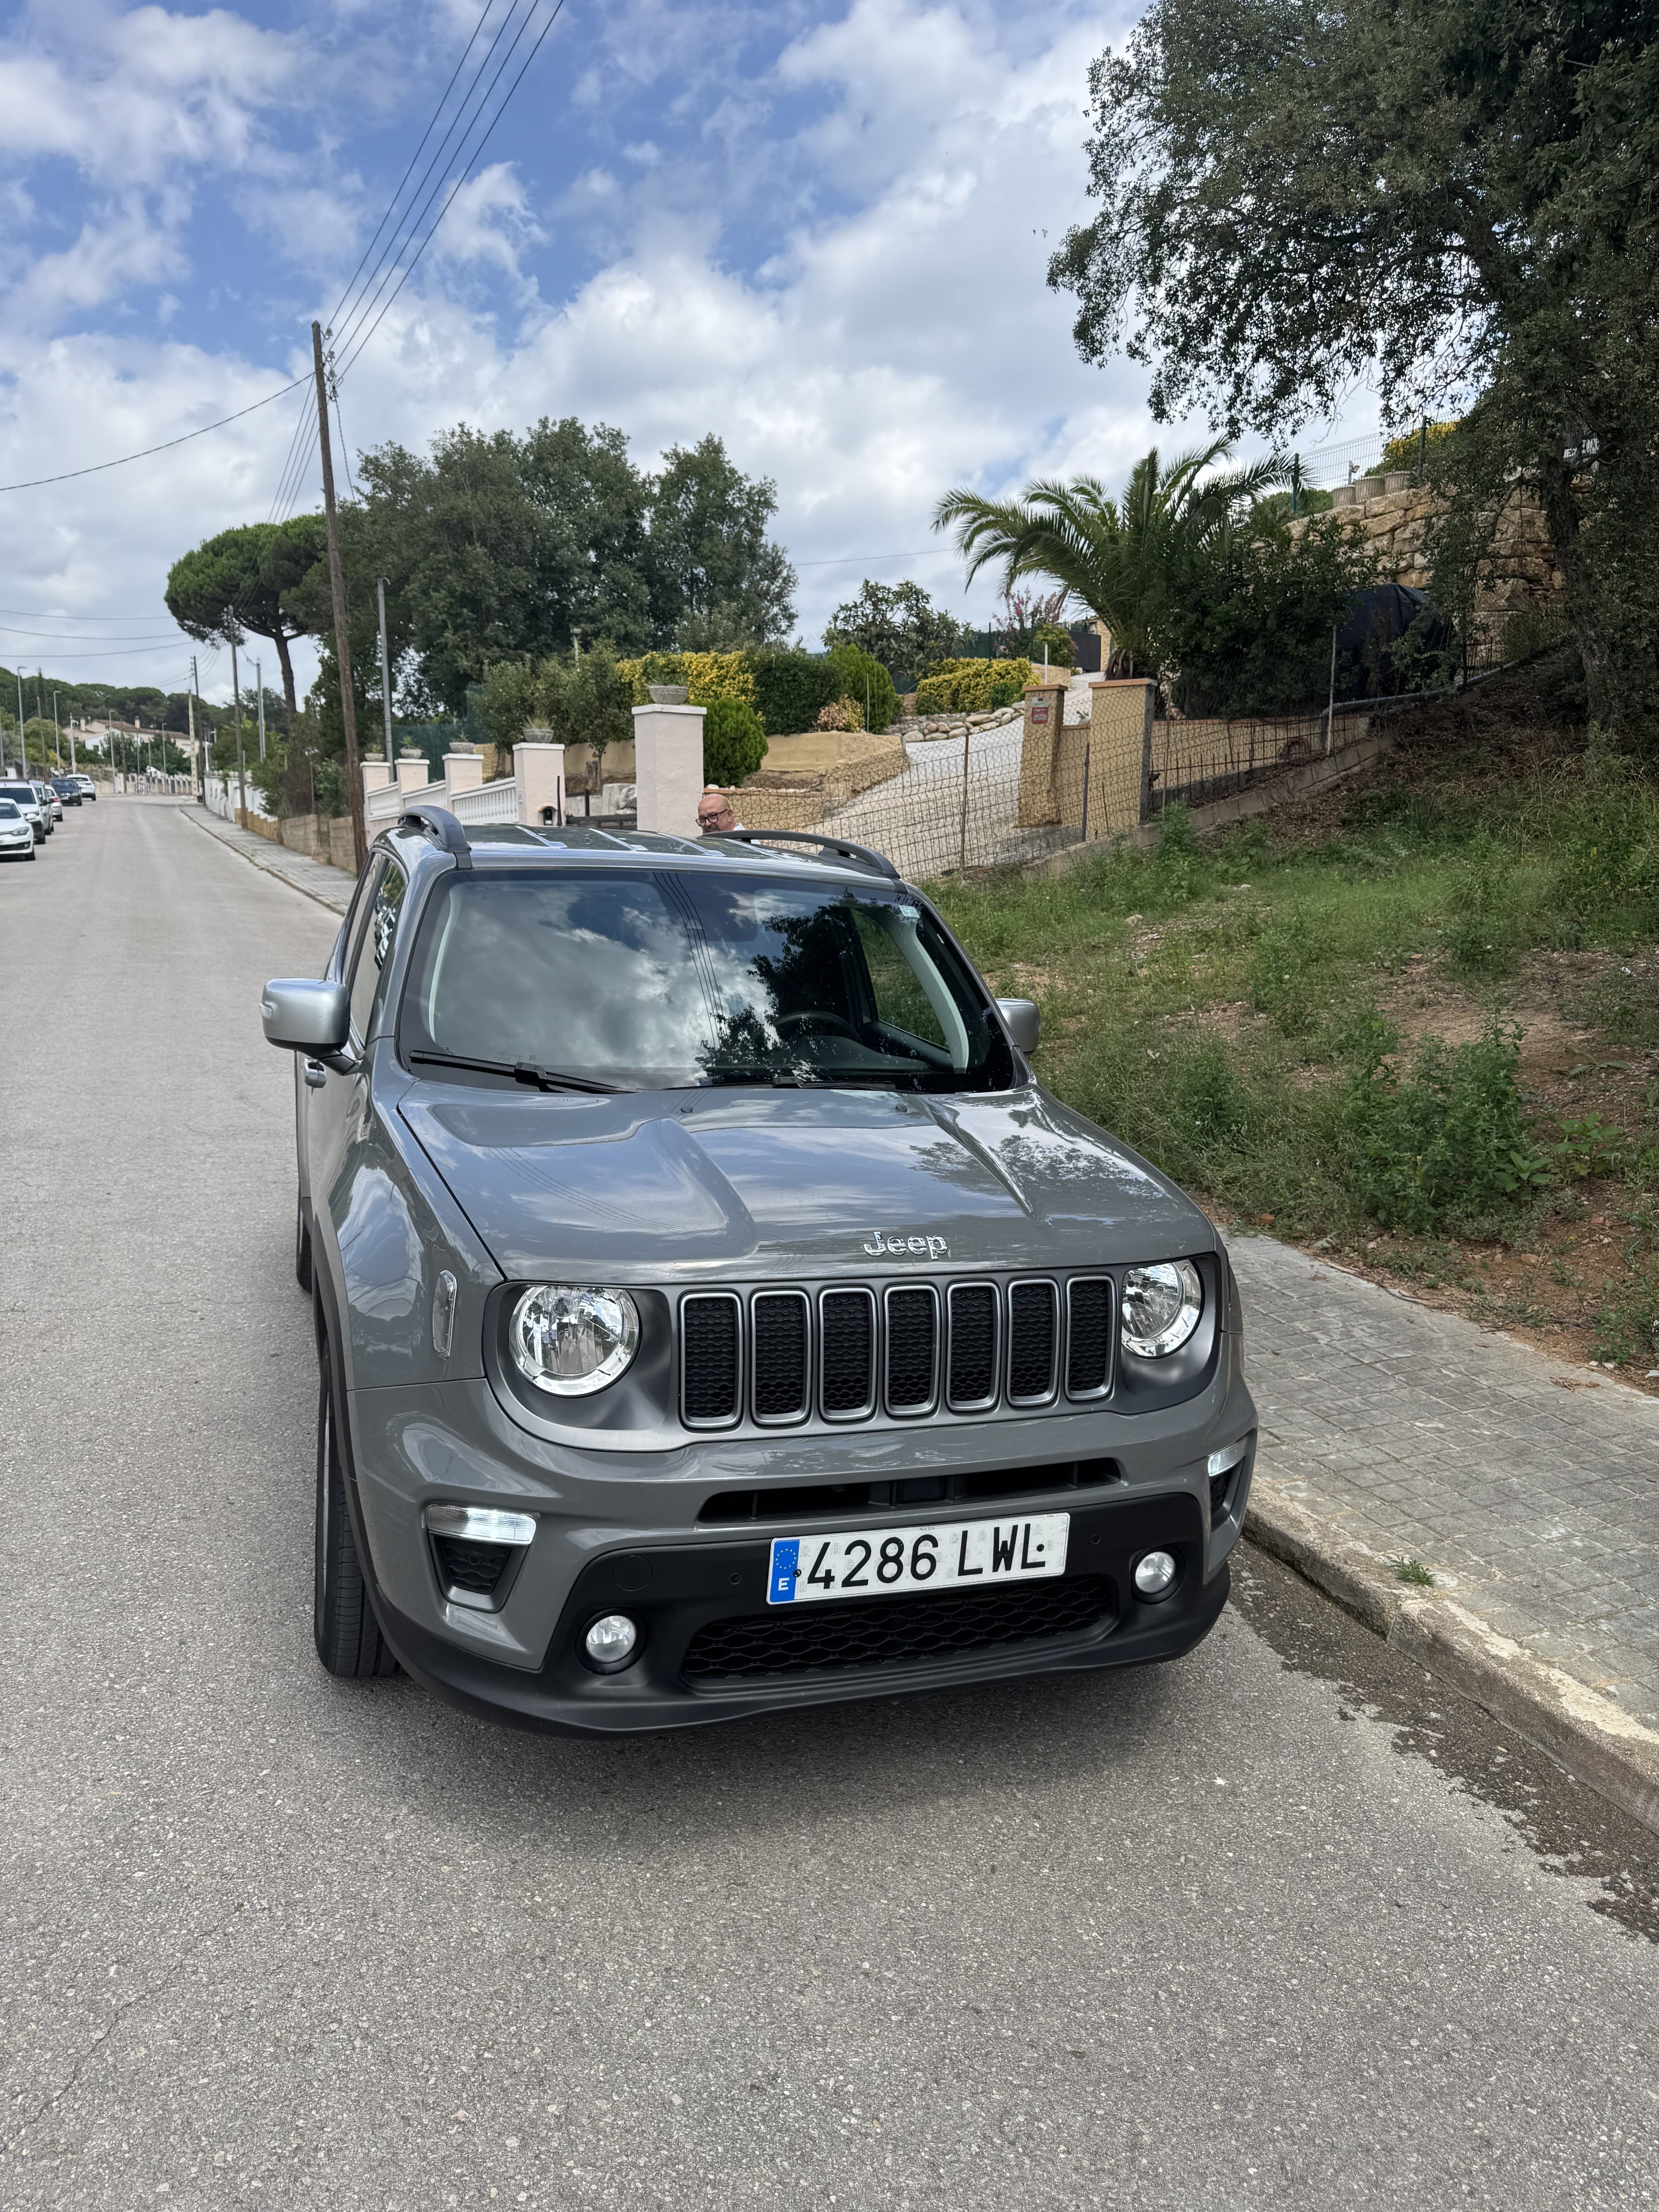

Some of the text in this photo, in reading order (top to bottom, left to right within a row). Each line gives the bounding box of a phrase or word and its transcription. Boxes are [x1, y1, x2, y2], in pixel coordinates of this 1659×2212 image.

[863, 1231, 948, 1261] Jeep
[778, 1523, 1046, 1591] E 4286 LWL
